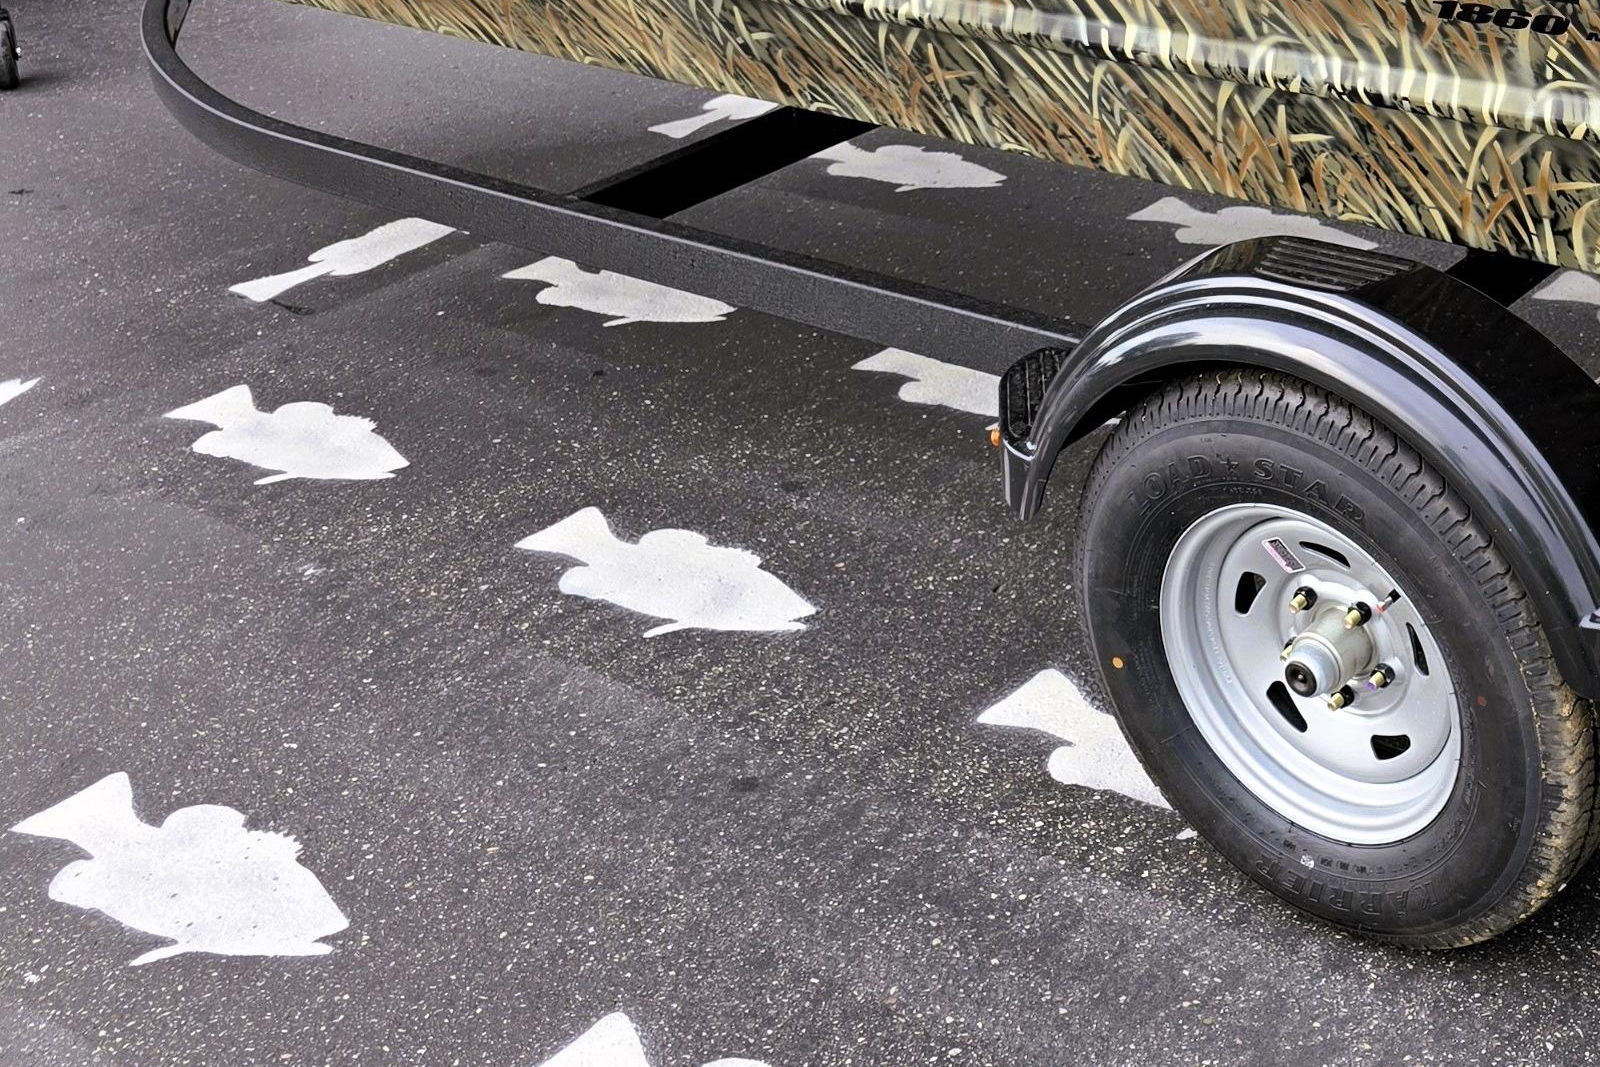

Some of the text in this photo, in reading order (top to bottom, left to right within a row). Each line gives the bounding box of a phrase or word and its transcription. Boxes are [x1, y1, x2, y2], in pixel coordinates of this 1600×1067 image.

[1432, 0, 1571, 35] 1860
[1127, 454, 1367, 524] LOAD STAR
[1254, 855, 1438, 916] KARRIER
